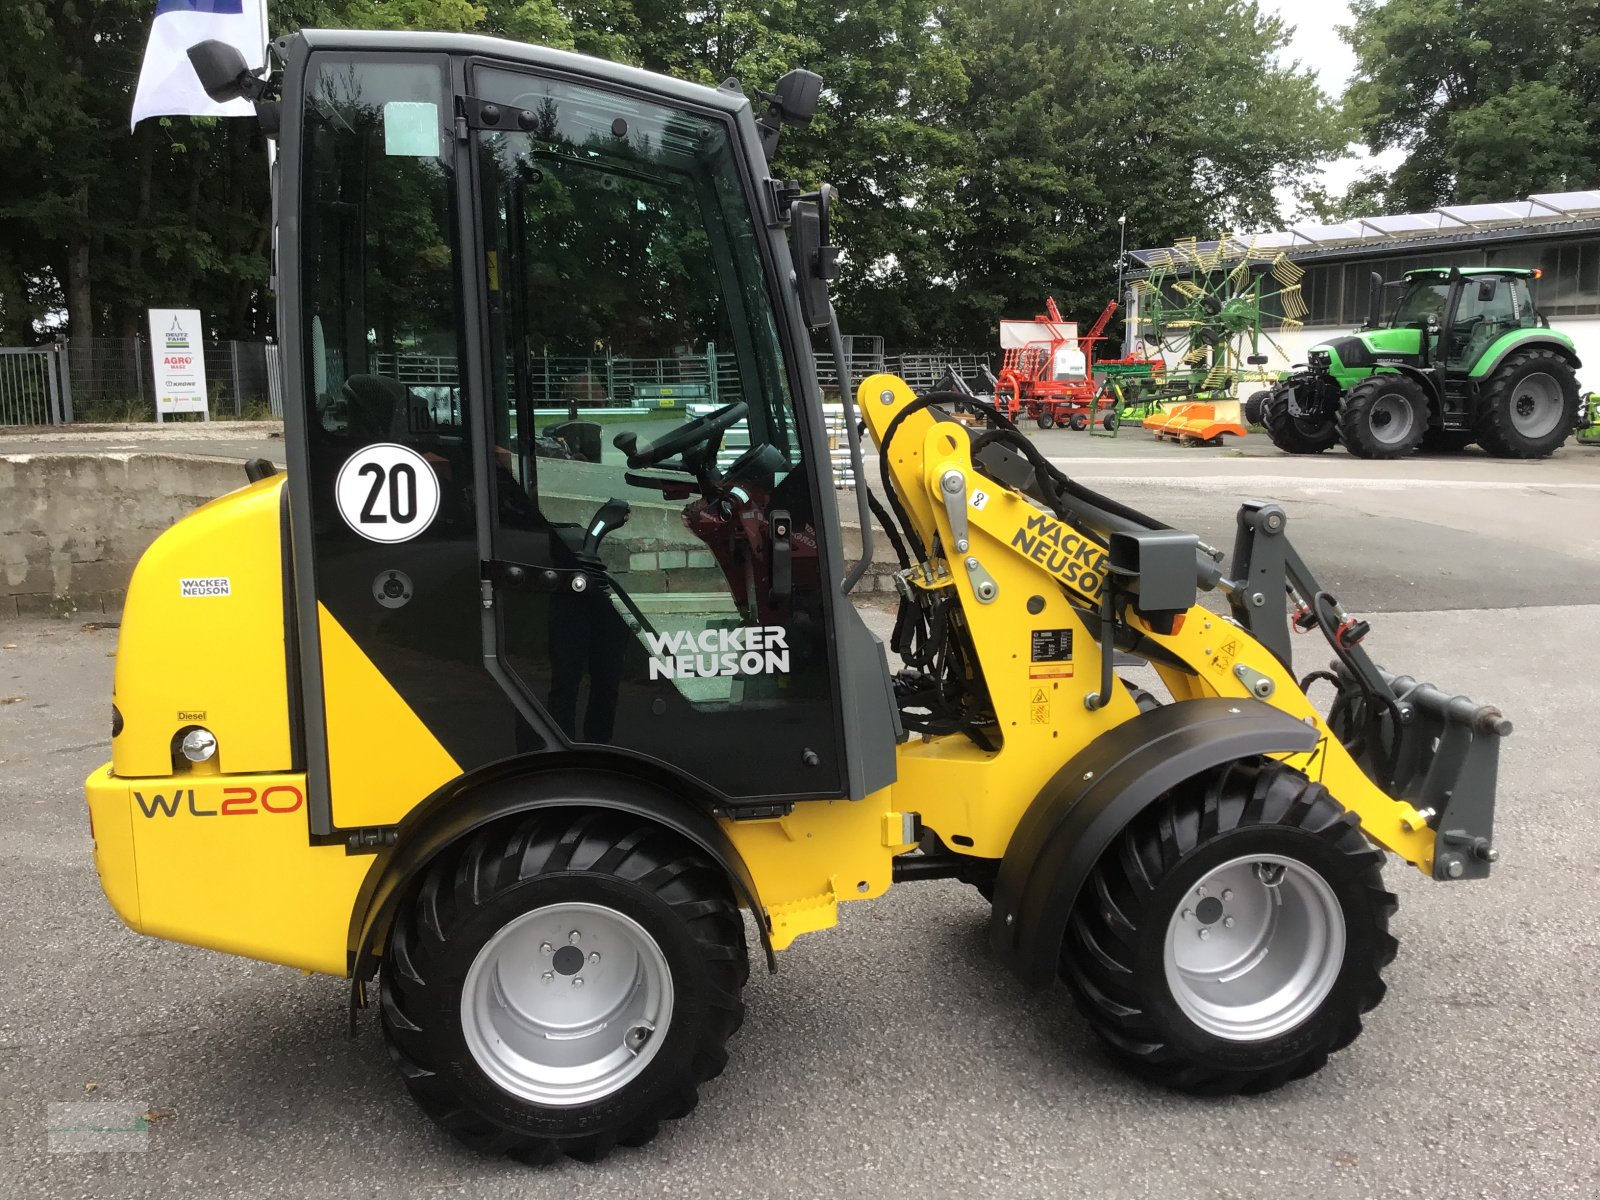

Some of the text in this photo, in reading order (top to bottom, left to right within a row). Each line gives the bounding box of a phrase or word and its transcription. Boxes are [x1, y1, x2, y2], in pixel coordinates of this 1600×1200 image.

[164, 357, 192, 365] AGRO
[358, 462, 417, 524] 20
[1027, 514, 1109, 577] WACKE
[182, 579, 228, 588] WACKER
[183, 587, 229, 595] NEUSON
[645, 626, 789, 655] WACKER
[649, 650, 790, 681] NEUSON
[178, 712, 206, 720] Diesel
[133, 785, 304, 819] WL20
